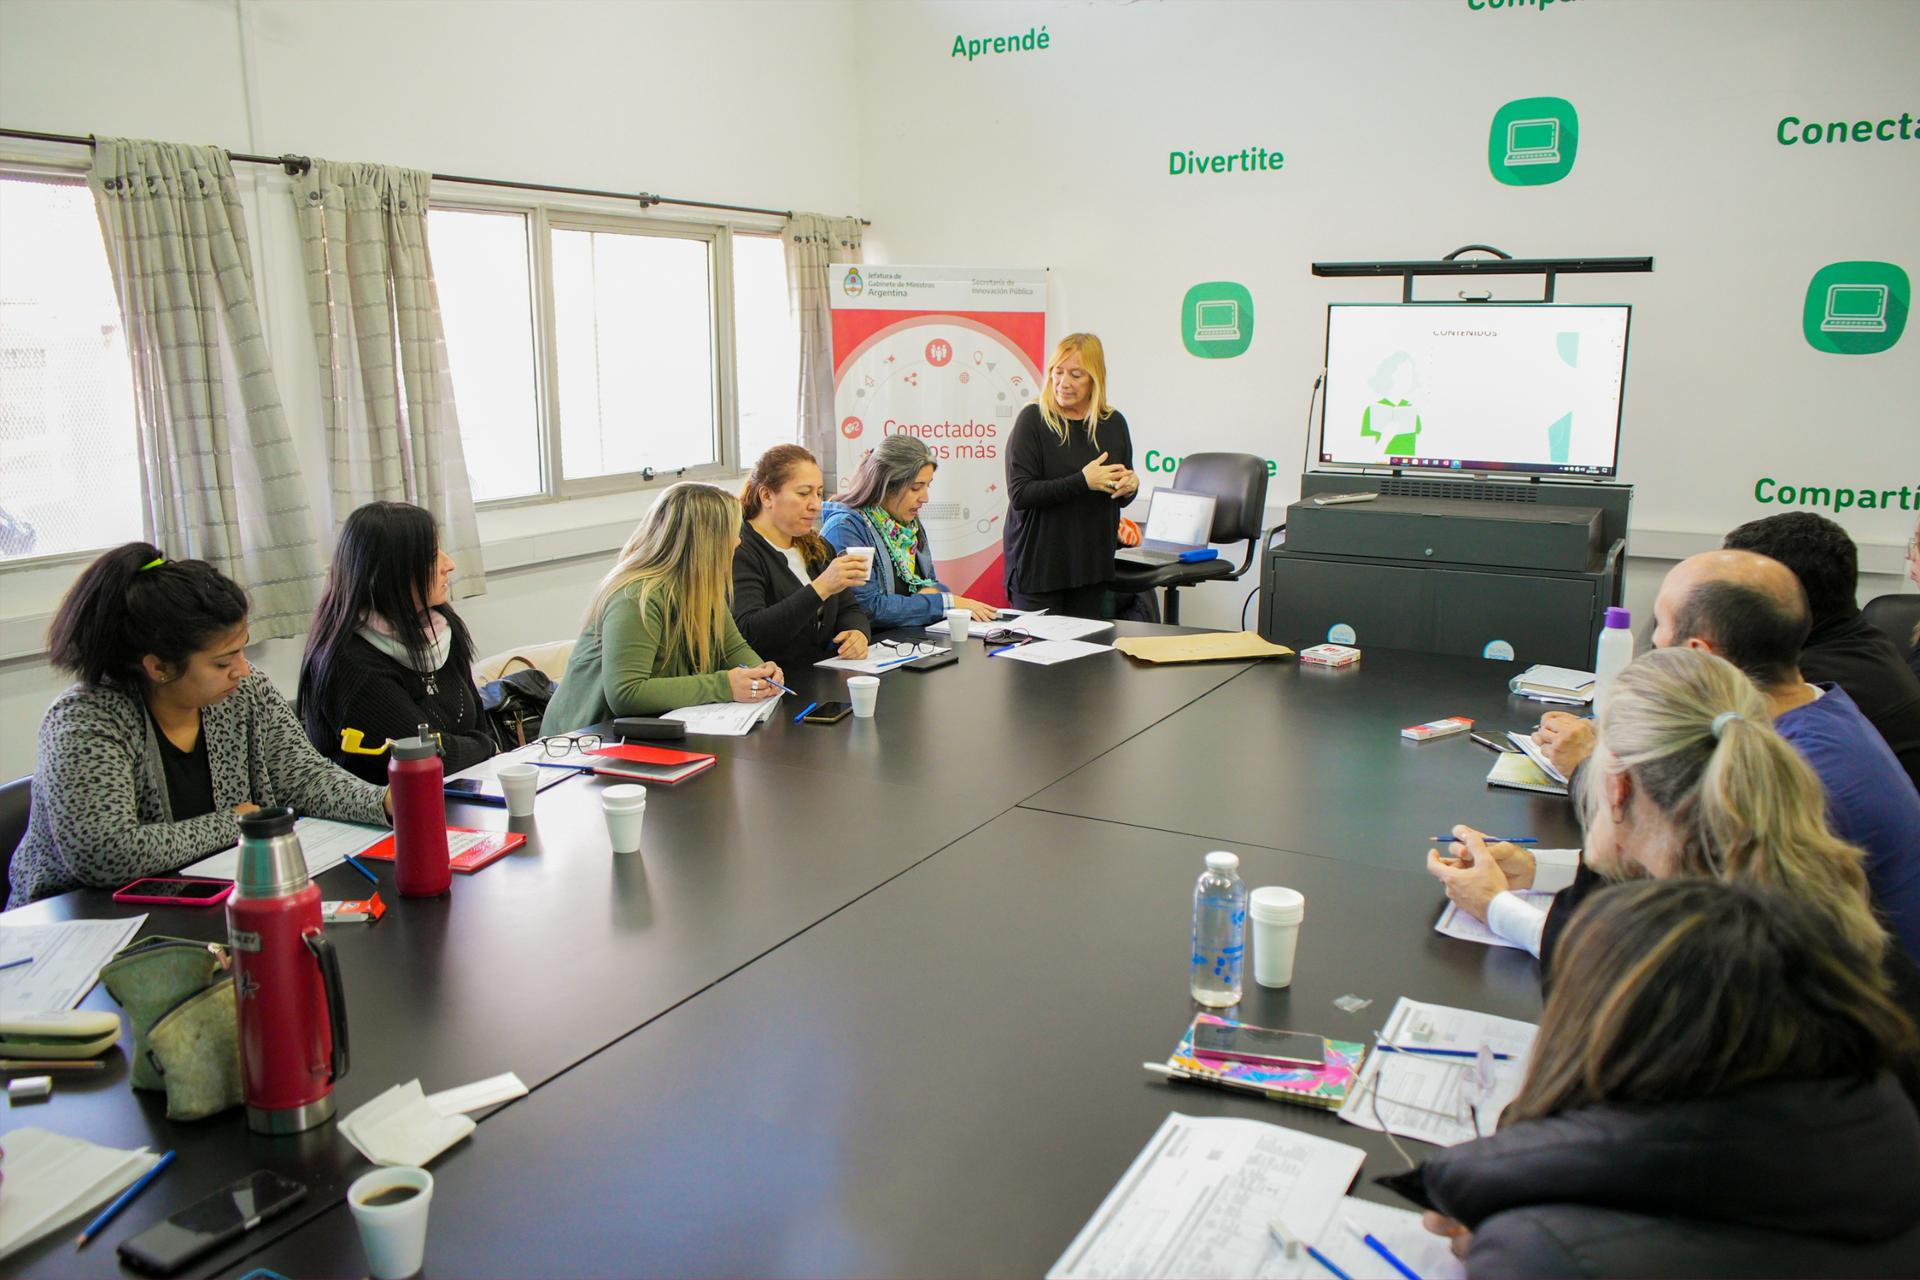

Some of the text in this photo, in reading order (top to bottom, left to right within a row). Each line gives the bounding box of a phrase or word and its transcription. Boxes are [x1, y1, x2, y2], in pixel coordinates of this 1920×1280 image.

[951, 25, 1050, 61] Aprendé
[1777, 112, 1920, 146] Conect
[1169, 146, 1284, 175] Divertite
[894, 272, 902, 280] de
[868, 288, 908, 298] Argentina
[883, 419, 997, 438] Conectados
[956, 440, 997, 459] más
